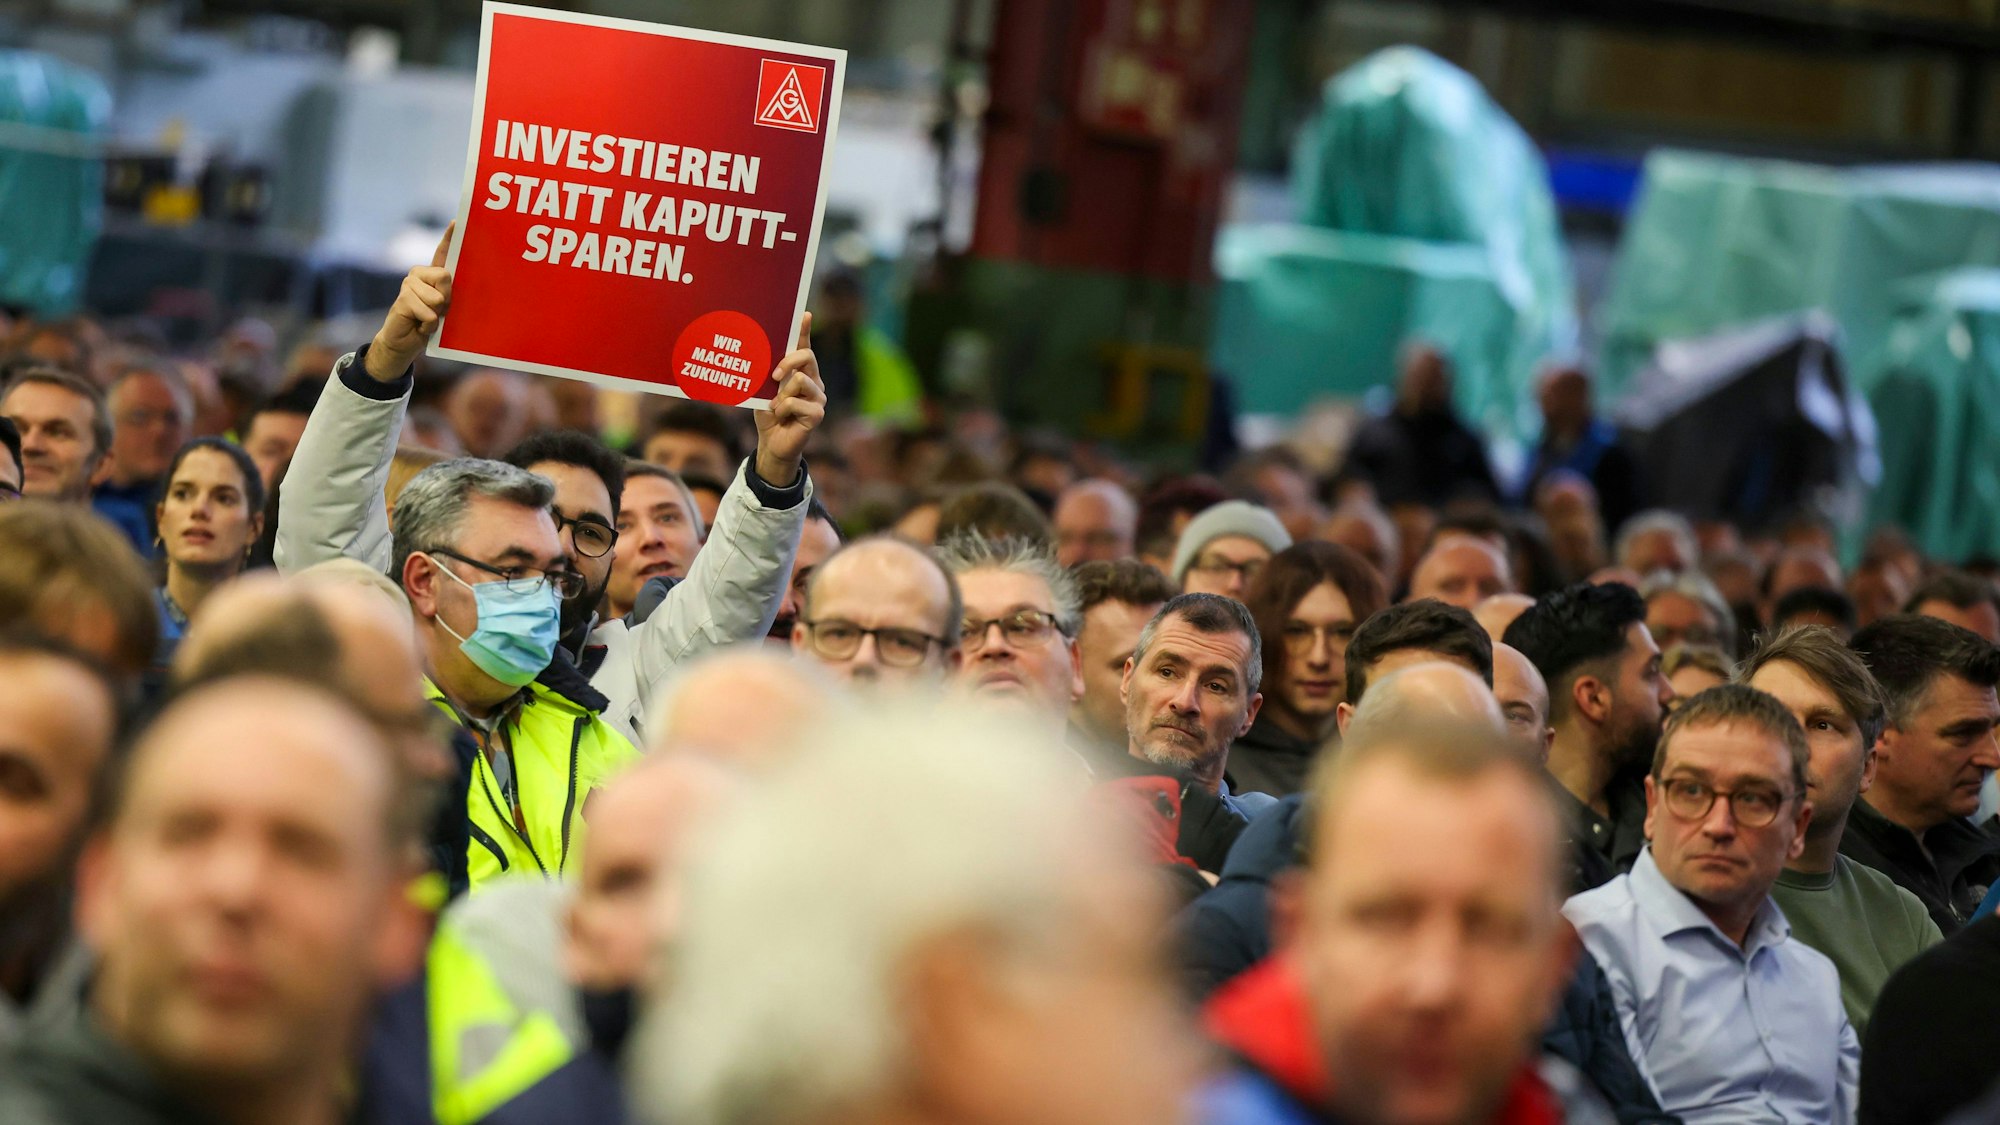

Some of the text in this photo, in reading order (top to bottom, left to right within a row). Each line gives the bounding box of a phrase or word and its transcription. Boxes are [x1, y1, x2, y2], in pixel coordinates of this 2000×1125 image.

[493, 119, 761, 195] INVESTIEREN
[484, 171, 797, 249] STATT KAPUTT-
[521, 224, 694, 285] SPAREN.
[691, 346, 752, 375] MACHEN
[713, 333, 742, 354] WIR
[680, 361, 752, 393] ZUKUNFT!
